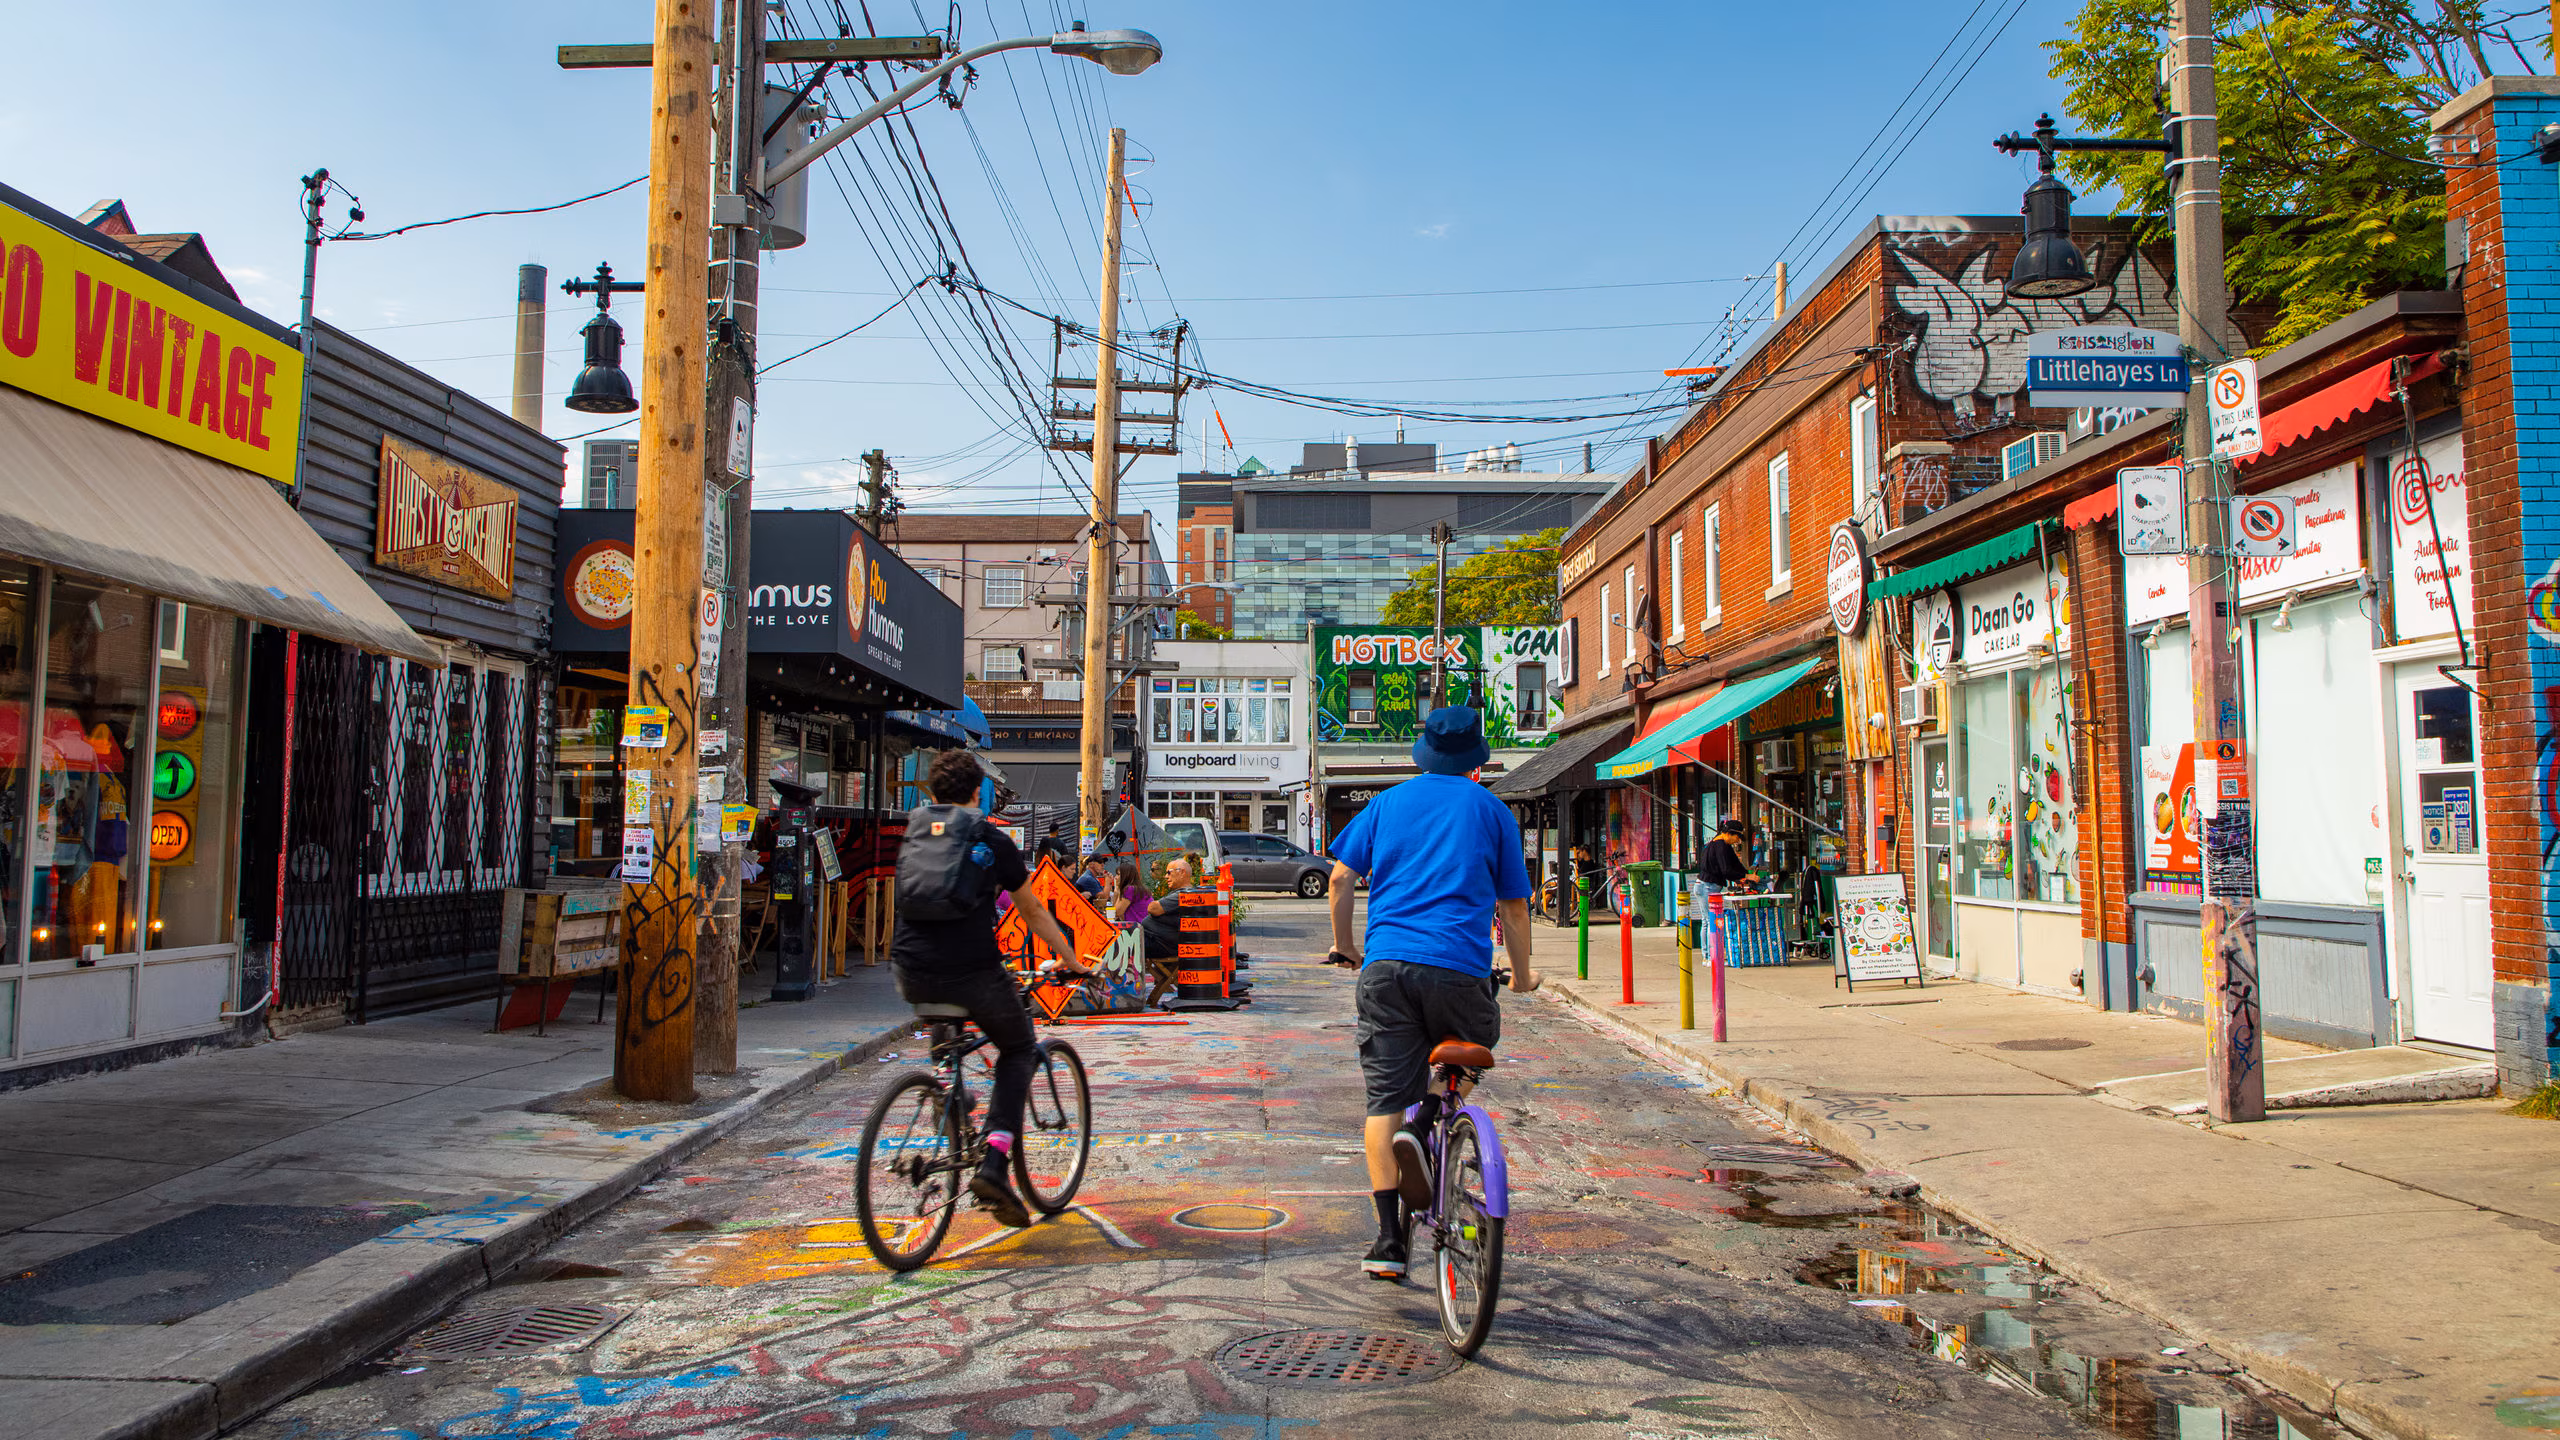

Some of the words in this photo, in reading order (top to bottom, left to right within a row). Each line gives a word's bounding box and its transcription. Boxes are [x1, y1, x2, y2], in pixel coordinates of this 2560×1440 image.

[75, 270, 275, 452] VINTAGE
[2038, 358, 2154, 388] Littlehayes
[2160, 364, 2179, 383] Ln
[2213, 416, 2220, 428] IN
[2222, 411, 2234, 425] THIS
[2238, 406, 2254, 421] LANE
[2228, 443, 2241, 453] AWAY
[2244, 439, 2258, 451] ZONE
[2131, 477, 2141, 485] NO
[2142, 475, 2167, 483] IDLING
[387, 449, 446, 553] THIRSTY
[2131, 515, 2160, 525] CHAPTER
[402, 546, 443, 565] PURVEYORS
[462, 500, 515, 591] MISERABLE
[2414, 536, 2460, 561] Authntic
[2239, 555, 2283, 584] aste
[2414, 564, 2462, 586] Peruan
[870, 559, 887, 605] Abu
[748, 584, 833, 608] mus
[748, 615, 776, 626] HE
[786, 615, 830, 626] LOVE
[868, 596, 904, 652] Hummus
[1971, 604, 2010, 636] Daan
[2012, 591, 2034, 624] Go
[1332, 634, 1468, 665] HOTBOX
[1984, 637, 2004, 654] CAKE
[2006, 632, 2020, 649] LAB
[867, 644, 883, 660] SPREAD
[892, 657, 902, 671] LOVE
[165, 704, 189, 715] WEL
[160, 715, 191, 727] COME
[1166, 754, 1236, 769] longboard
[1240, 754, 1280, 770] living
[2217, 803, 2236, 811] SSIST
[2423, 807, 2445, 816] NOTICE
[151, 825, 183, 847] OPEN
[1182, 919, 1200, 928] EVA
